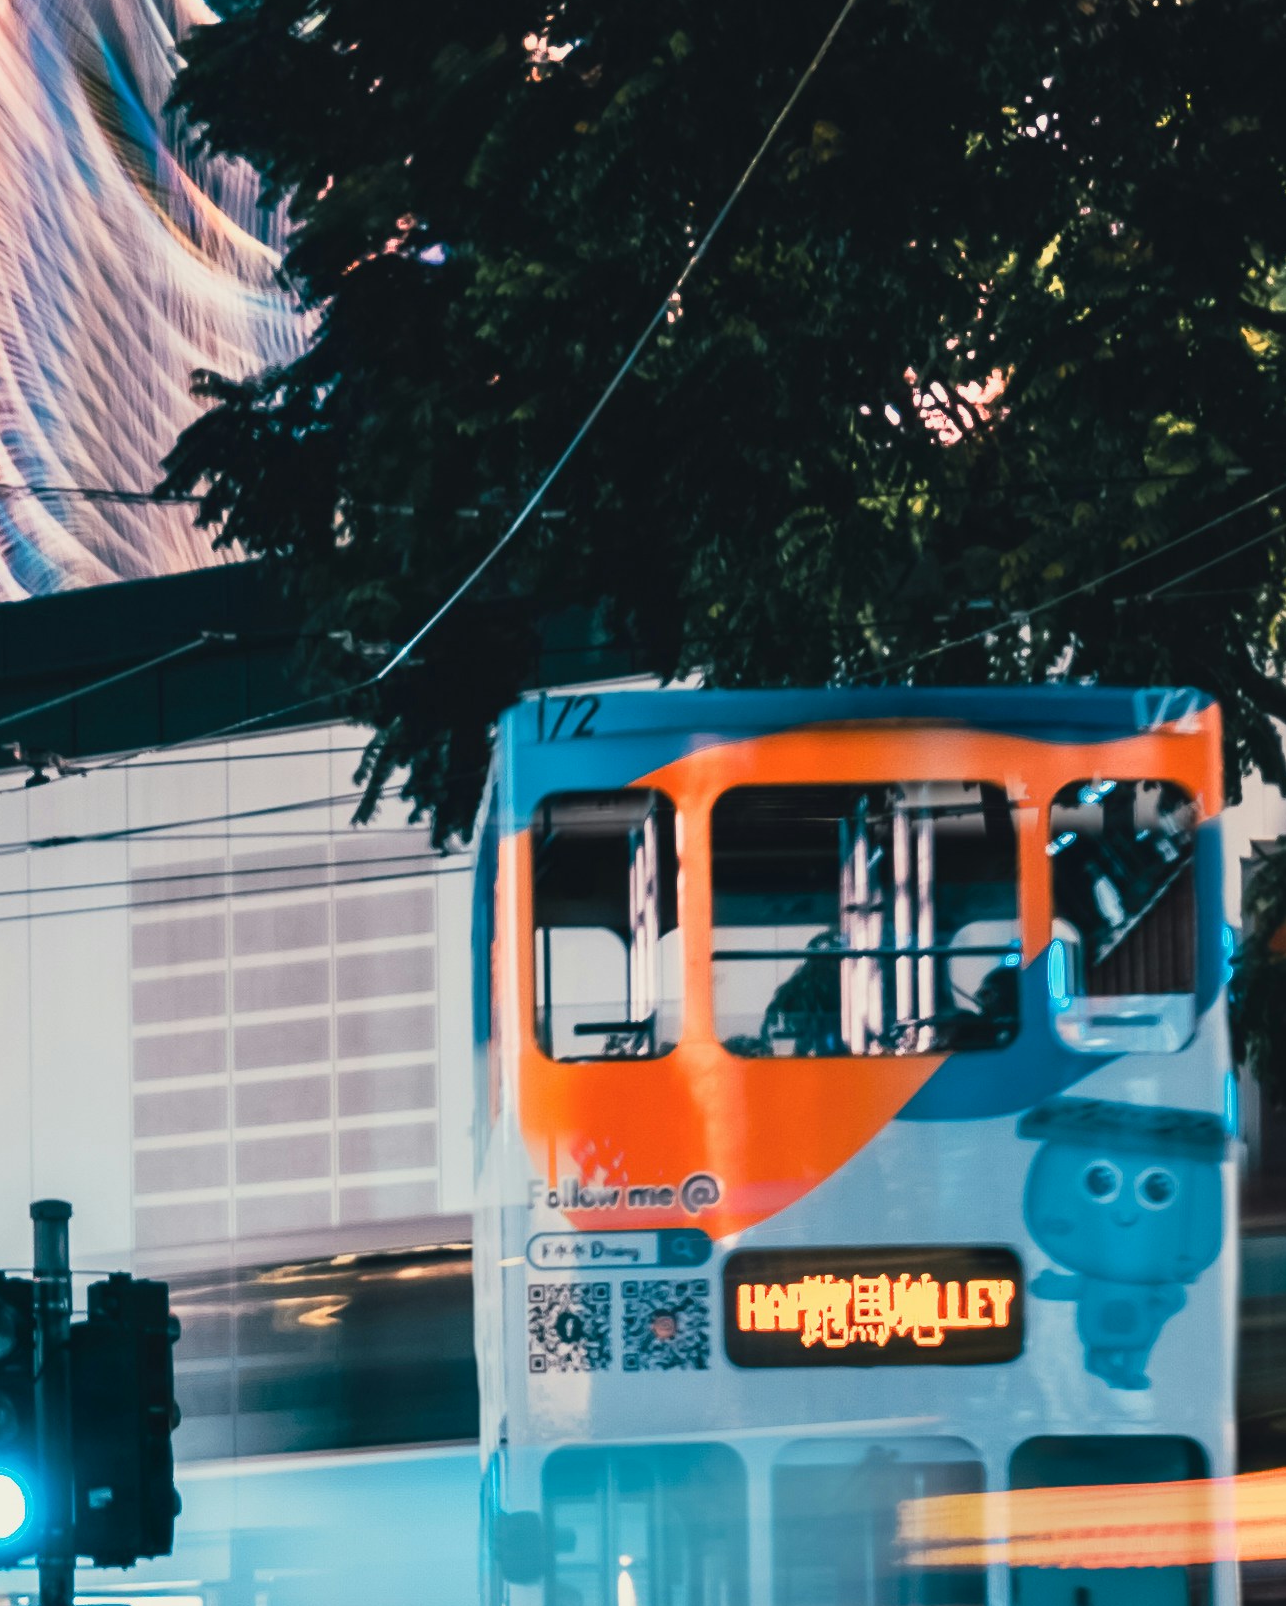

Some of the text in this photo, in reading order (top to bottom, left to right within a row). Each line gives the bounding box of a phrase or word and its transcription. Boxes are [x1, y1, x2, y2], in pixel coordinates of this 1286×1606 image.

[538, 692, 601, 743] 172
[526, 1177, 619, 1210] Follow
[628, 1186, 675, 1208] me
